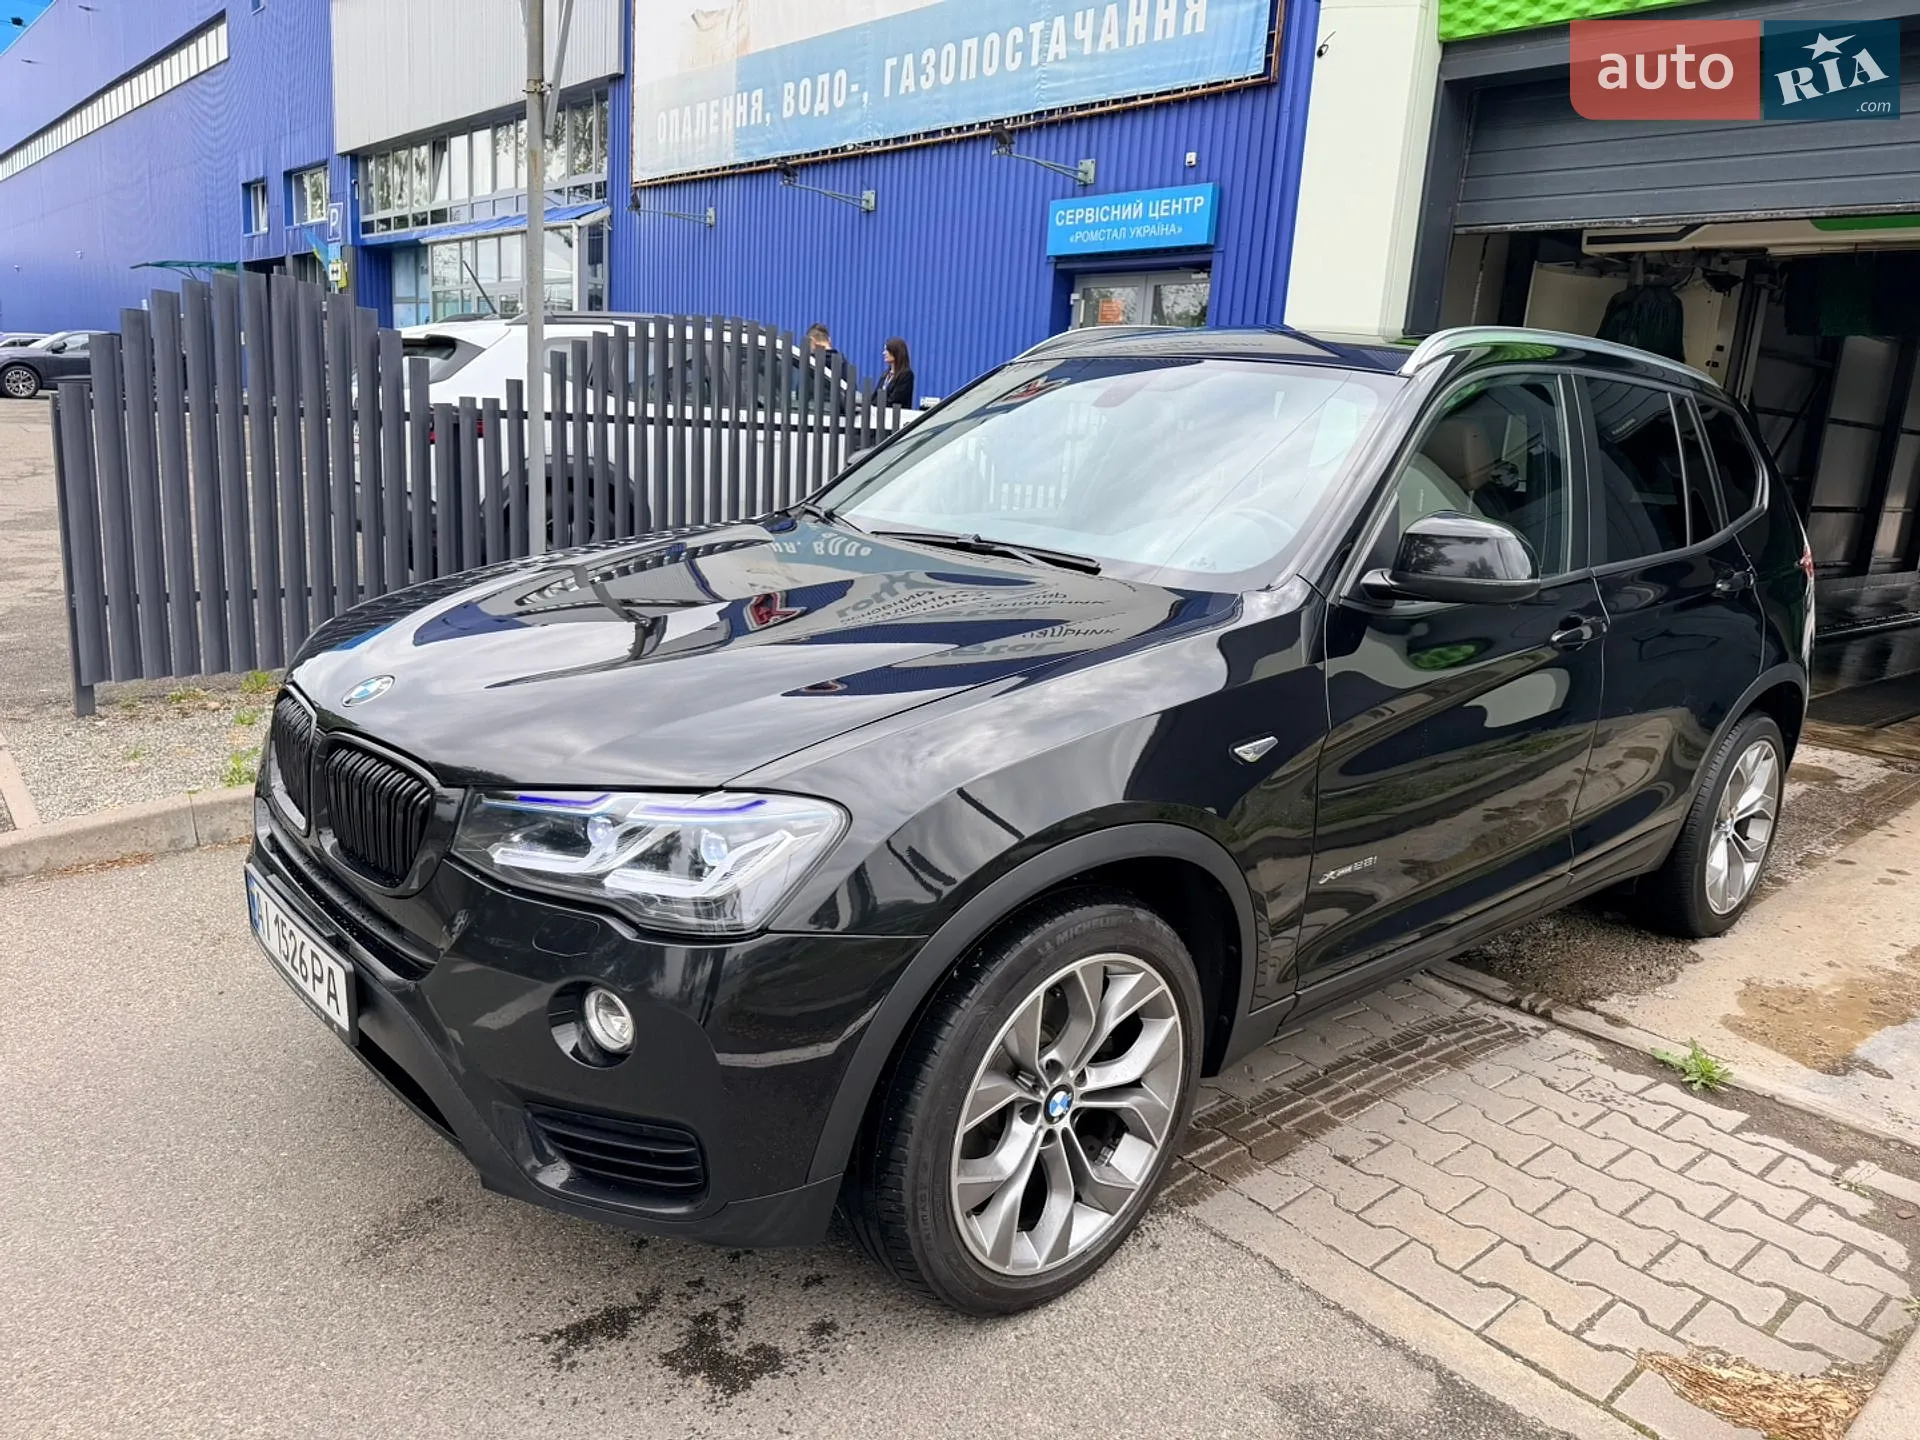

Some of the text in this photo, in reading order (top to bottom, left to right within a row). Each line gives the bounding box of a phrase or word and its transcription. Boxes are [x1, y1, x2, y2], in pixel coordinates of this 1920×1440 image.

[656, 88, 772, 143] ОПАЛЕННЯ,
[883, 0, 1209, 98] ГАЗОПОСТАЧАННЯ
[330, 207, 339, 237] P
[1055, 196, 1205, 226] СЕРВІСНИЙ ЦЕНТР
[1069, 223, 1182, 243] «РОМСТАЛ УКРАЇНА»
